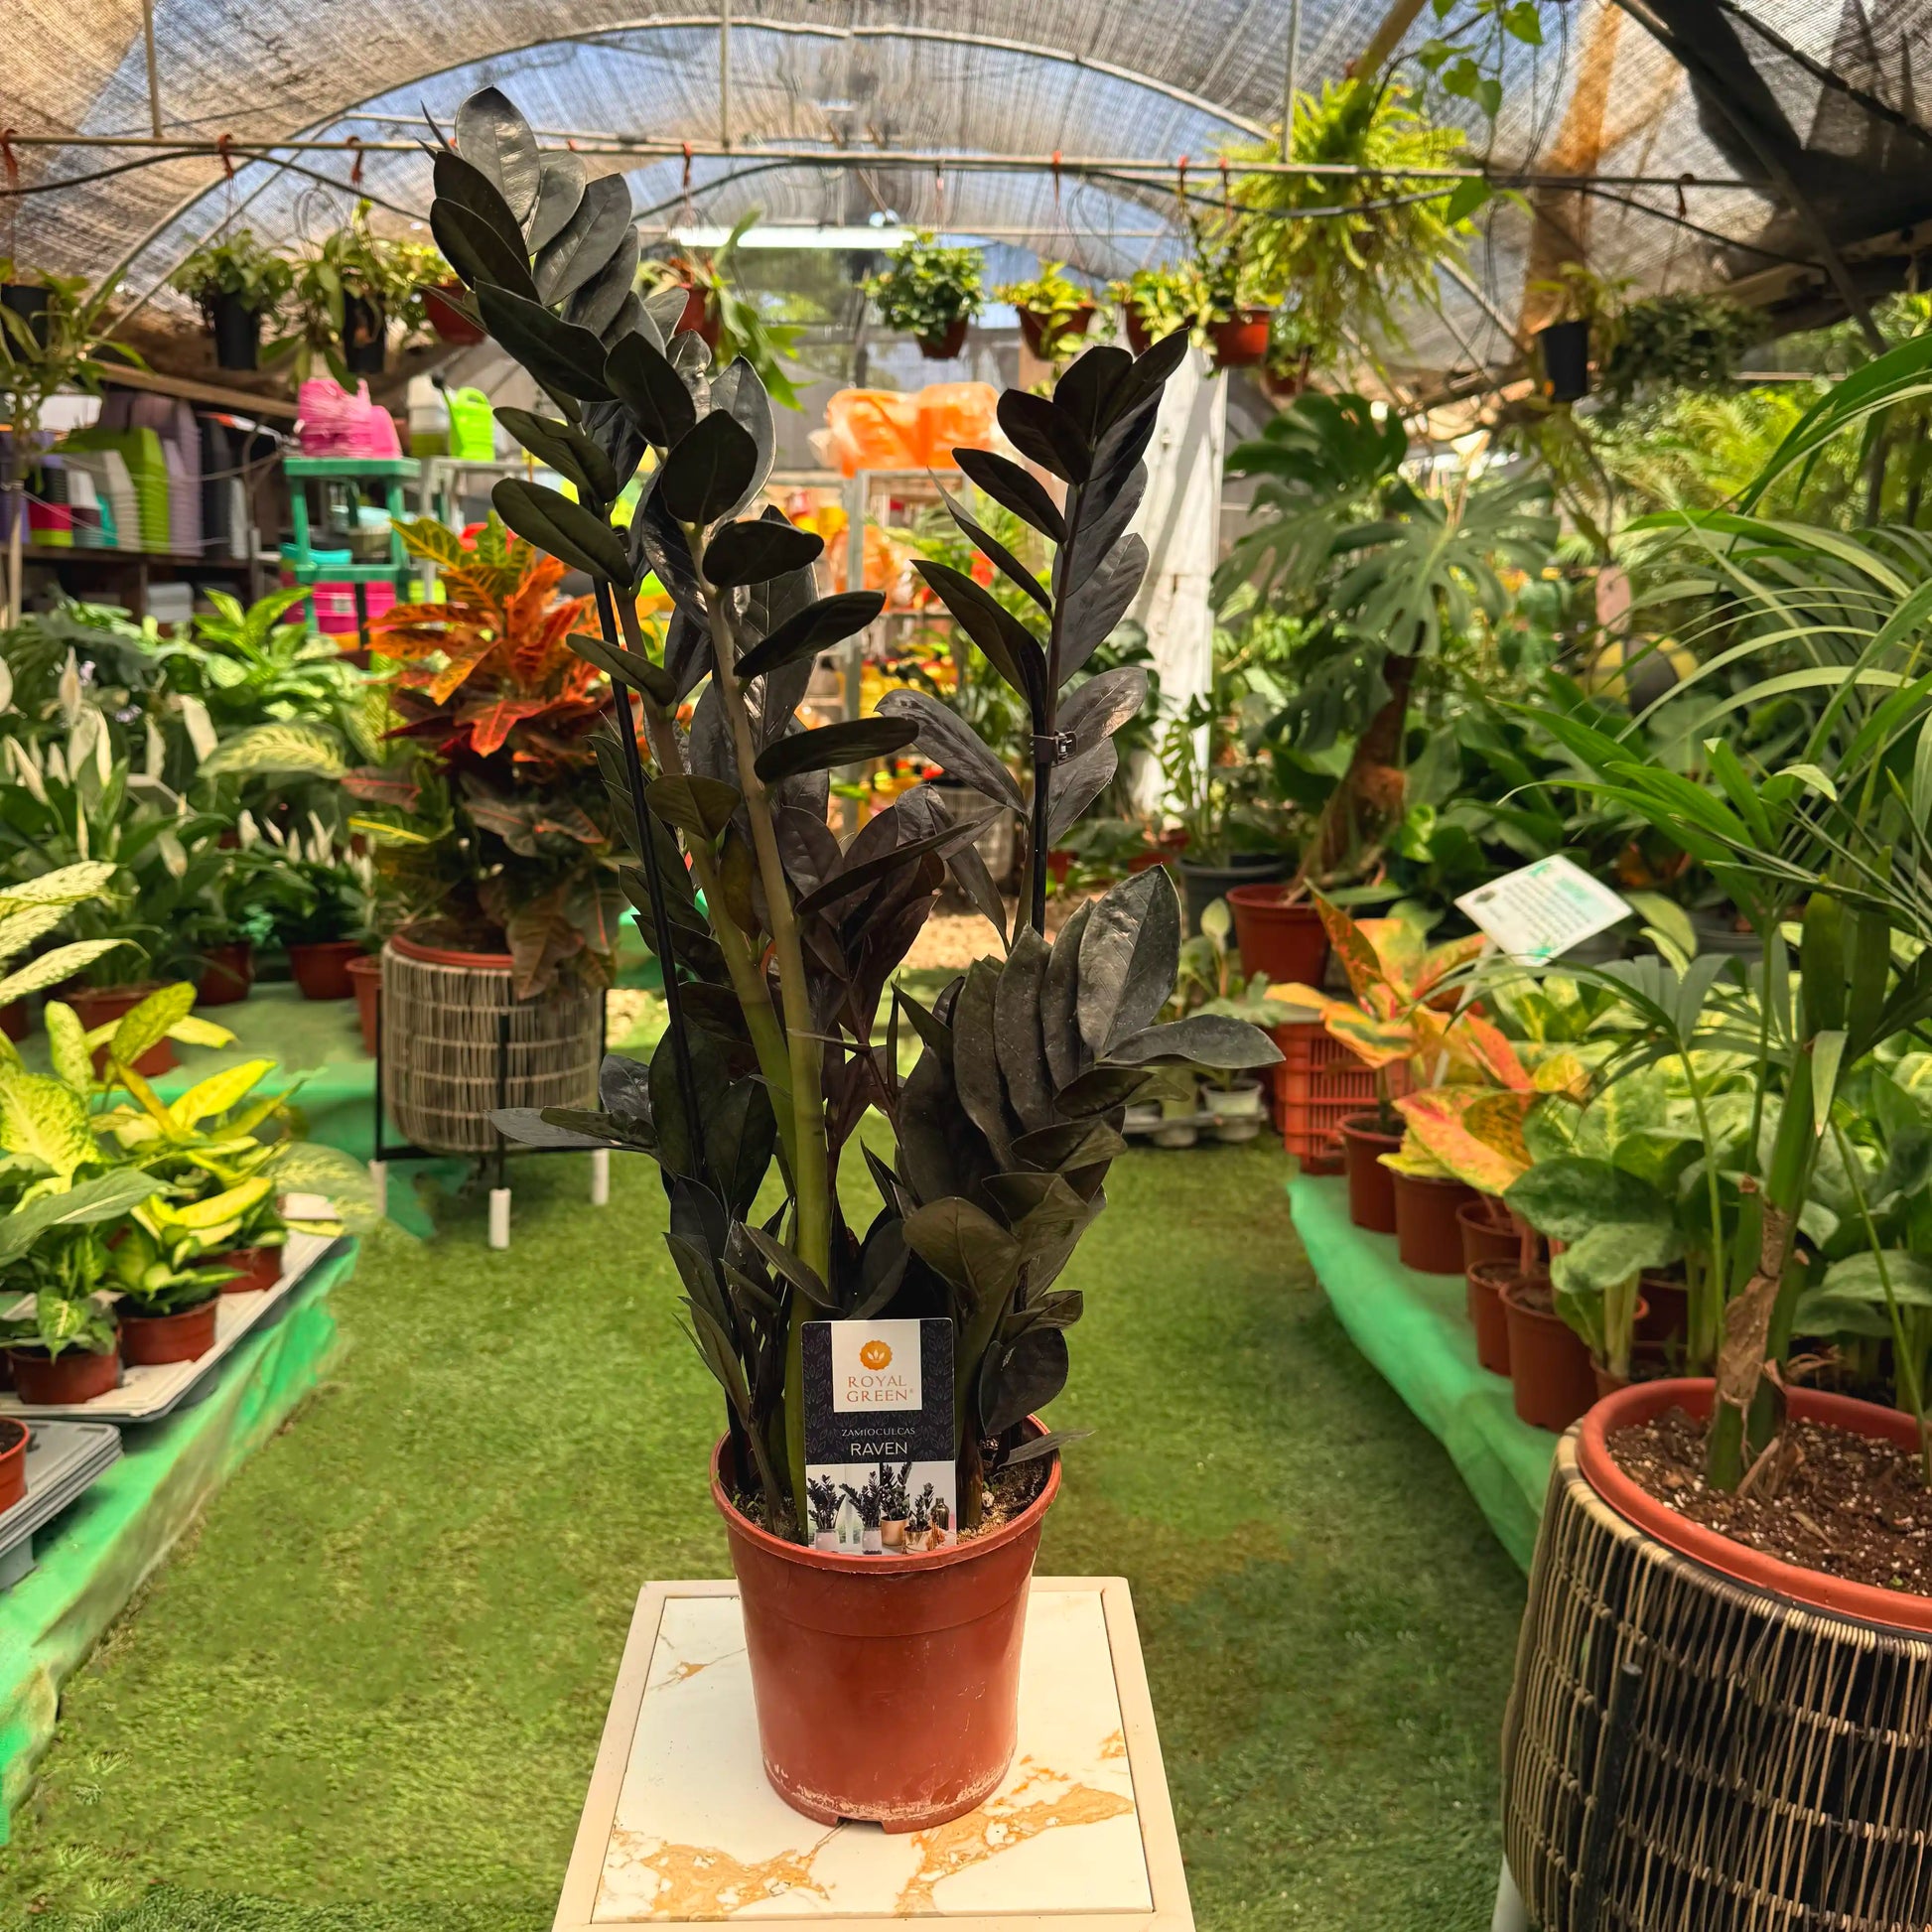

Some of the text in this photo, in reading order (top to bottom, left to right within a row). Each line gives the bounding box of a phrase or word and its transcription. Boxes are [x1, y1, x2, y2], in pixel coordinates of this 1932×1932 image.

[848, 1375, 907, 1388] ROYAL
[841, 1428, 915, 1437] ZAMIOCULCAS
[850, 1442, 907, 1456] RAVEN
